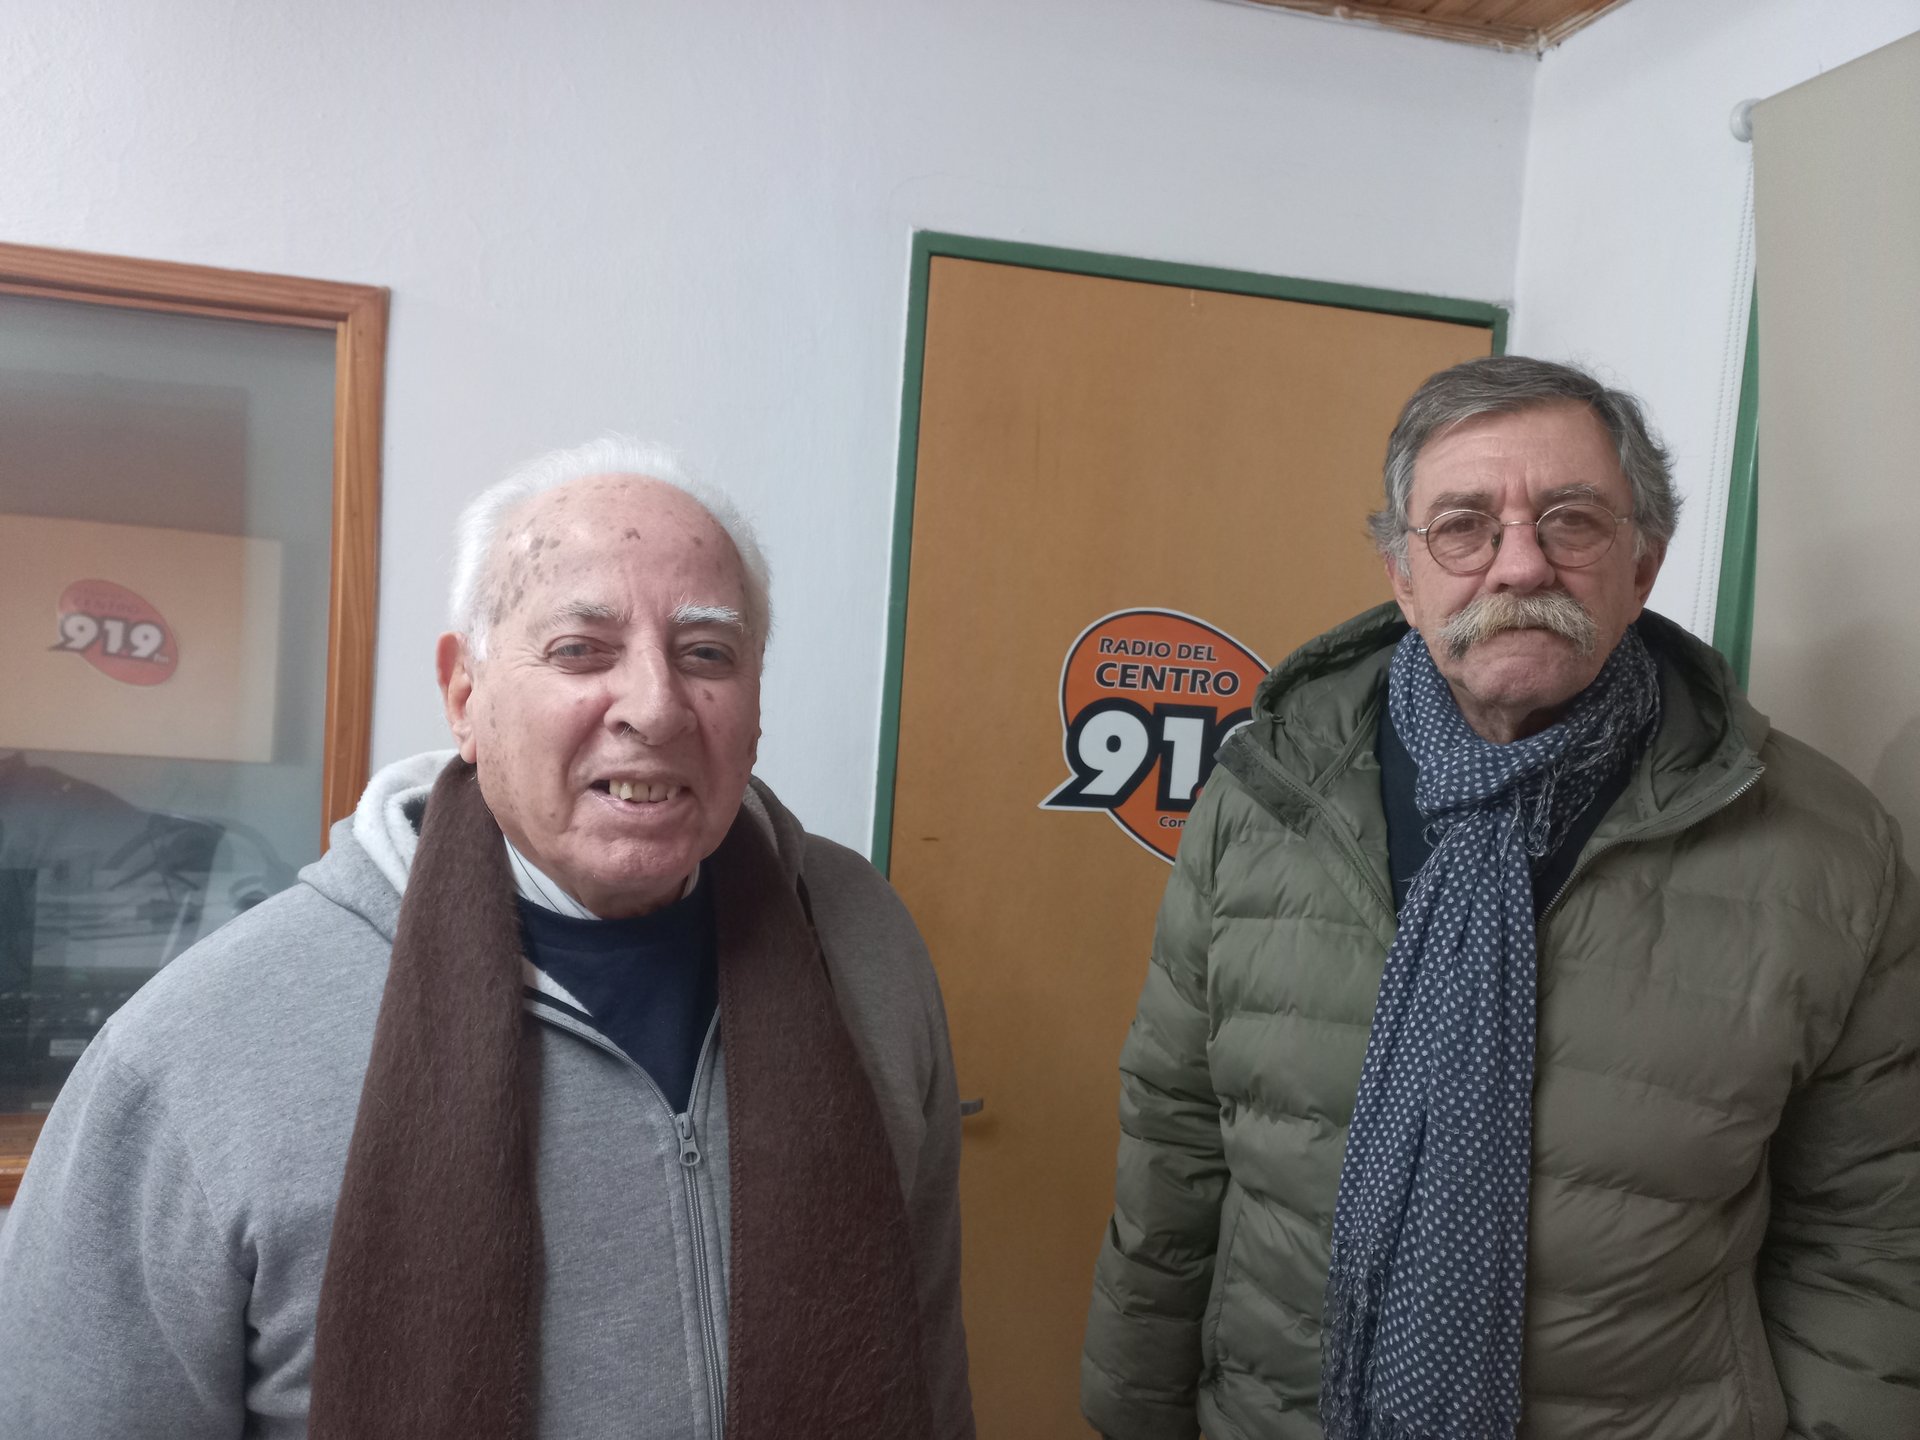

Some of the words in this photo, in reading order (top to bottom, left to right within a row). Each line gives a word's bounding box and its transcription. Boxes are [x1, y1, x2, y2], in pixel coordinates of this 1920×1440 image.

[1099, 637, 1172, 659] RADIO
[1176, 643, 1217, 662] DEL
[1095, 662, 1240, 696] CENTRO
[1076, 707, 1254, 802] 91
